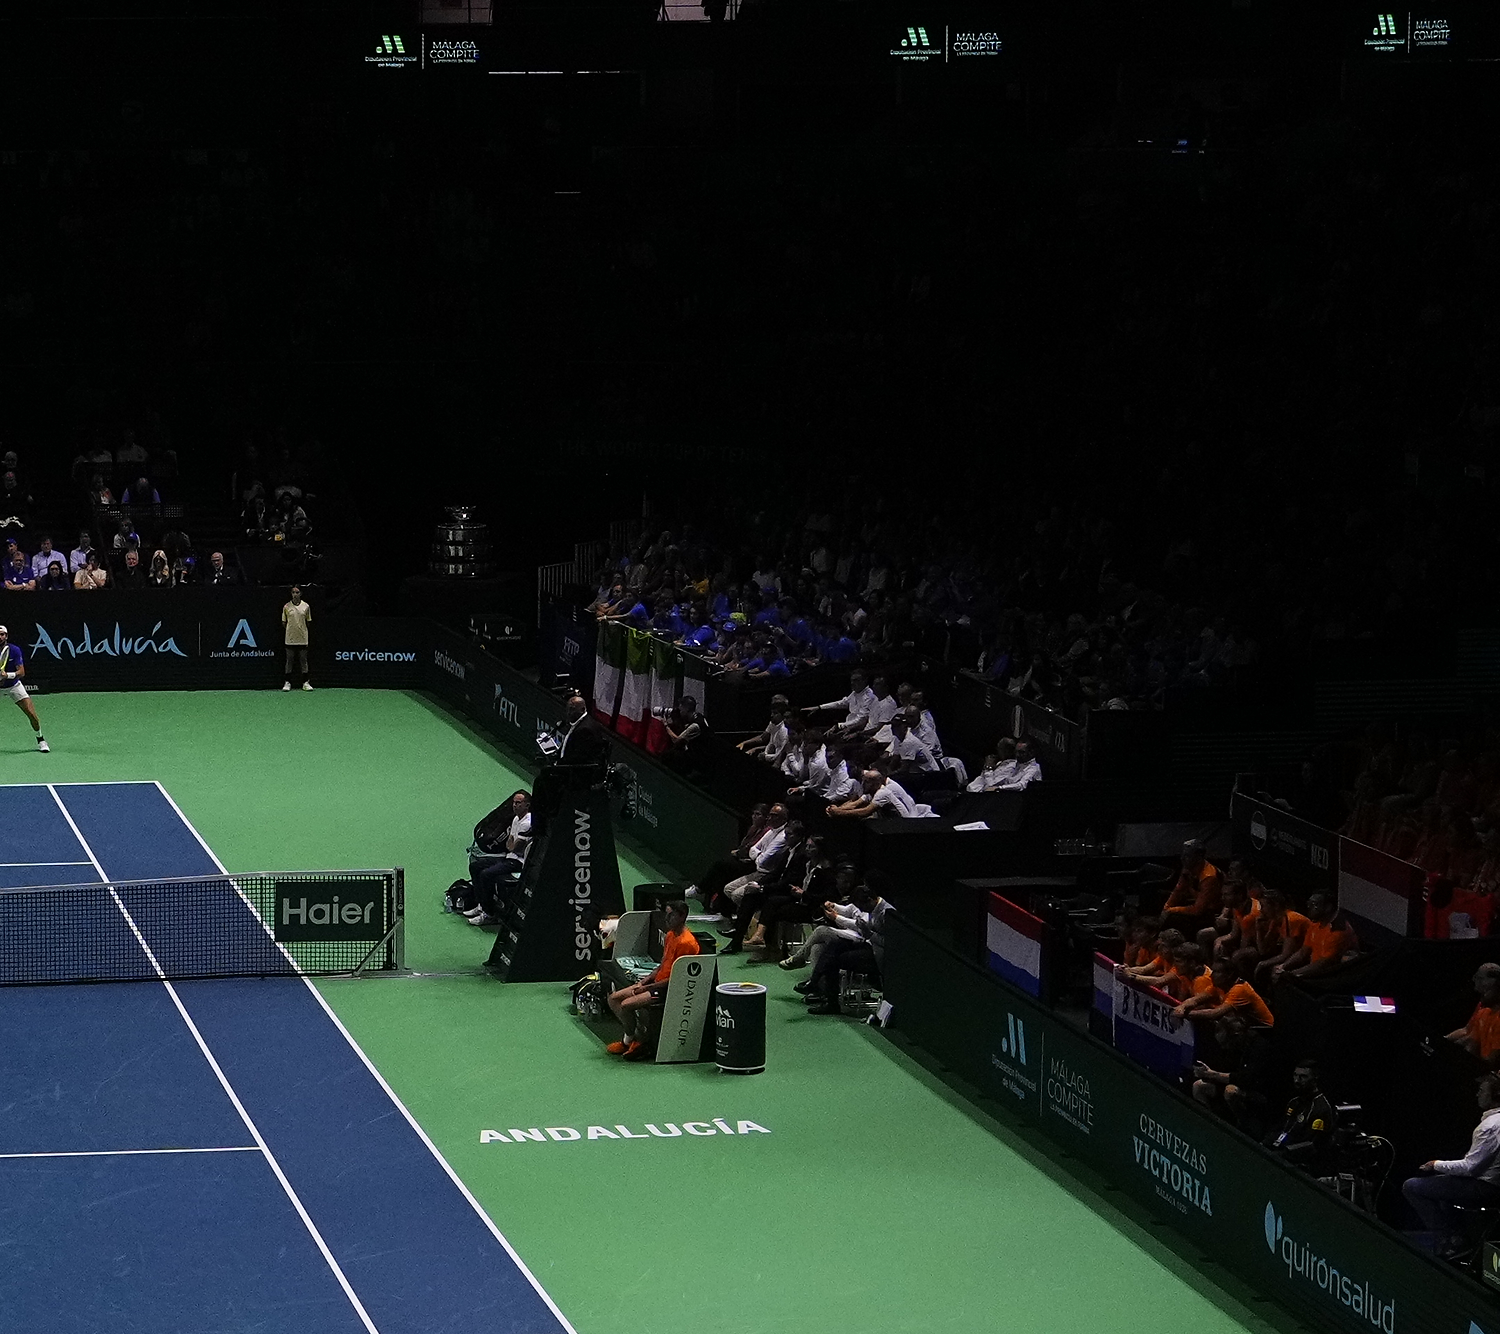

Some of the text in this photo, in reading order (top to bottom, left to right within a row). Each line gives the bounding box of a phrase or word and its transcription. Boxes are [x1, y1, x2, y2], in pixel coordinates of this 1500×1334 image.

[432, 39, 476, 49] MÁLAGA
[953, 41, 1002, 52] COMPITE
[956, 31, 999, 41] MÁLAGA
[429, 50, 480, 59] COMPITE
[29, 620, 188, 661] Andalucía
[500, 697, 521, 728] ATL
[282, 896, 375, 927] Haier
[678, 980, 696, 1046] DAVIS CUP
[1051, 1058, 1091, 1099] MÁLAGA
[1047, 1078, 1094, 1126] COMPITE
[479, 1118, 772, 1144] ANDALUCÍA
[1139, 1113, 1208, 1176] CERVEZAS
[1132, 1134, 1213, 1217] VICTORIA
